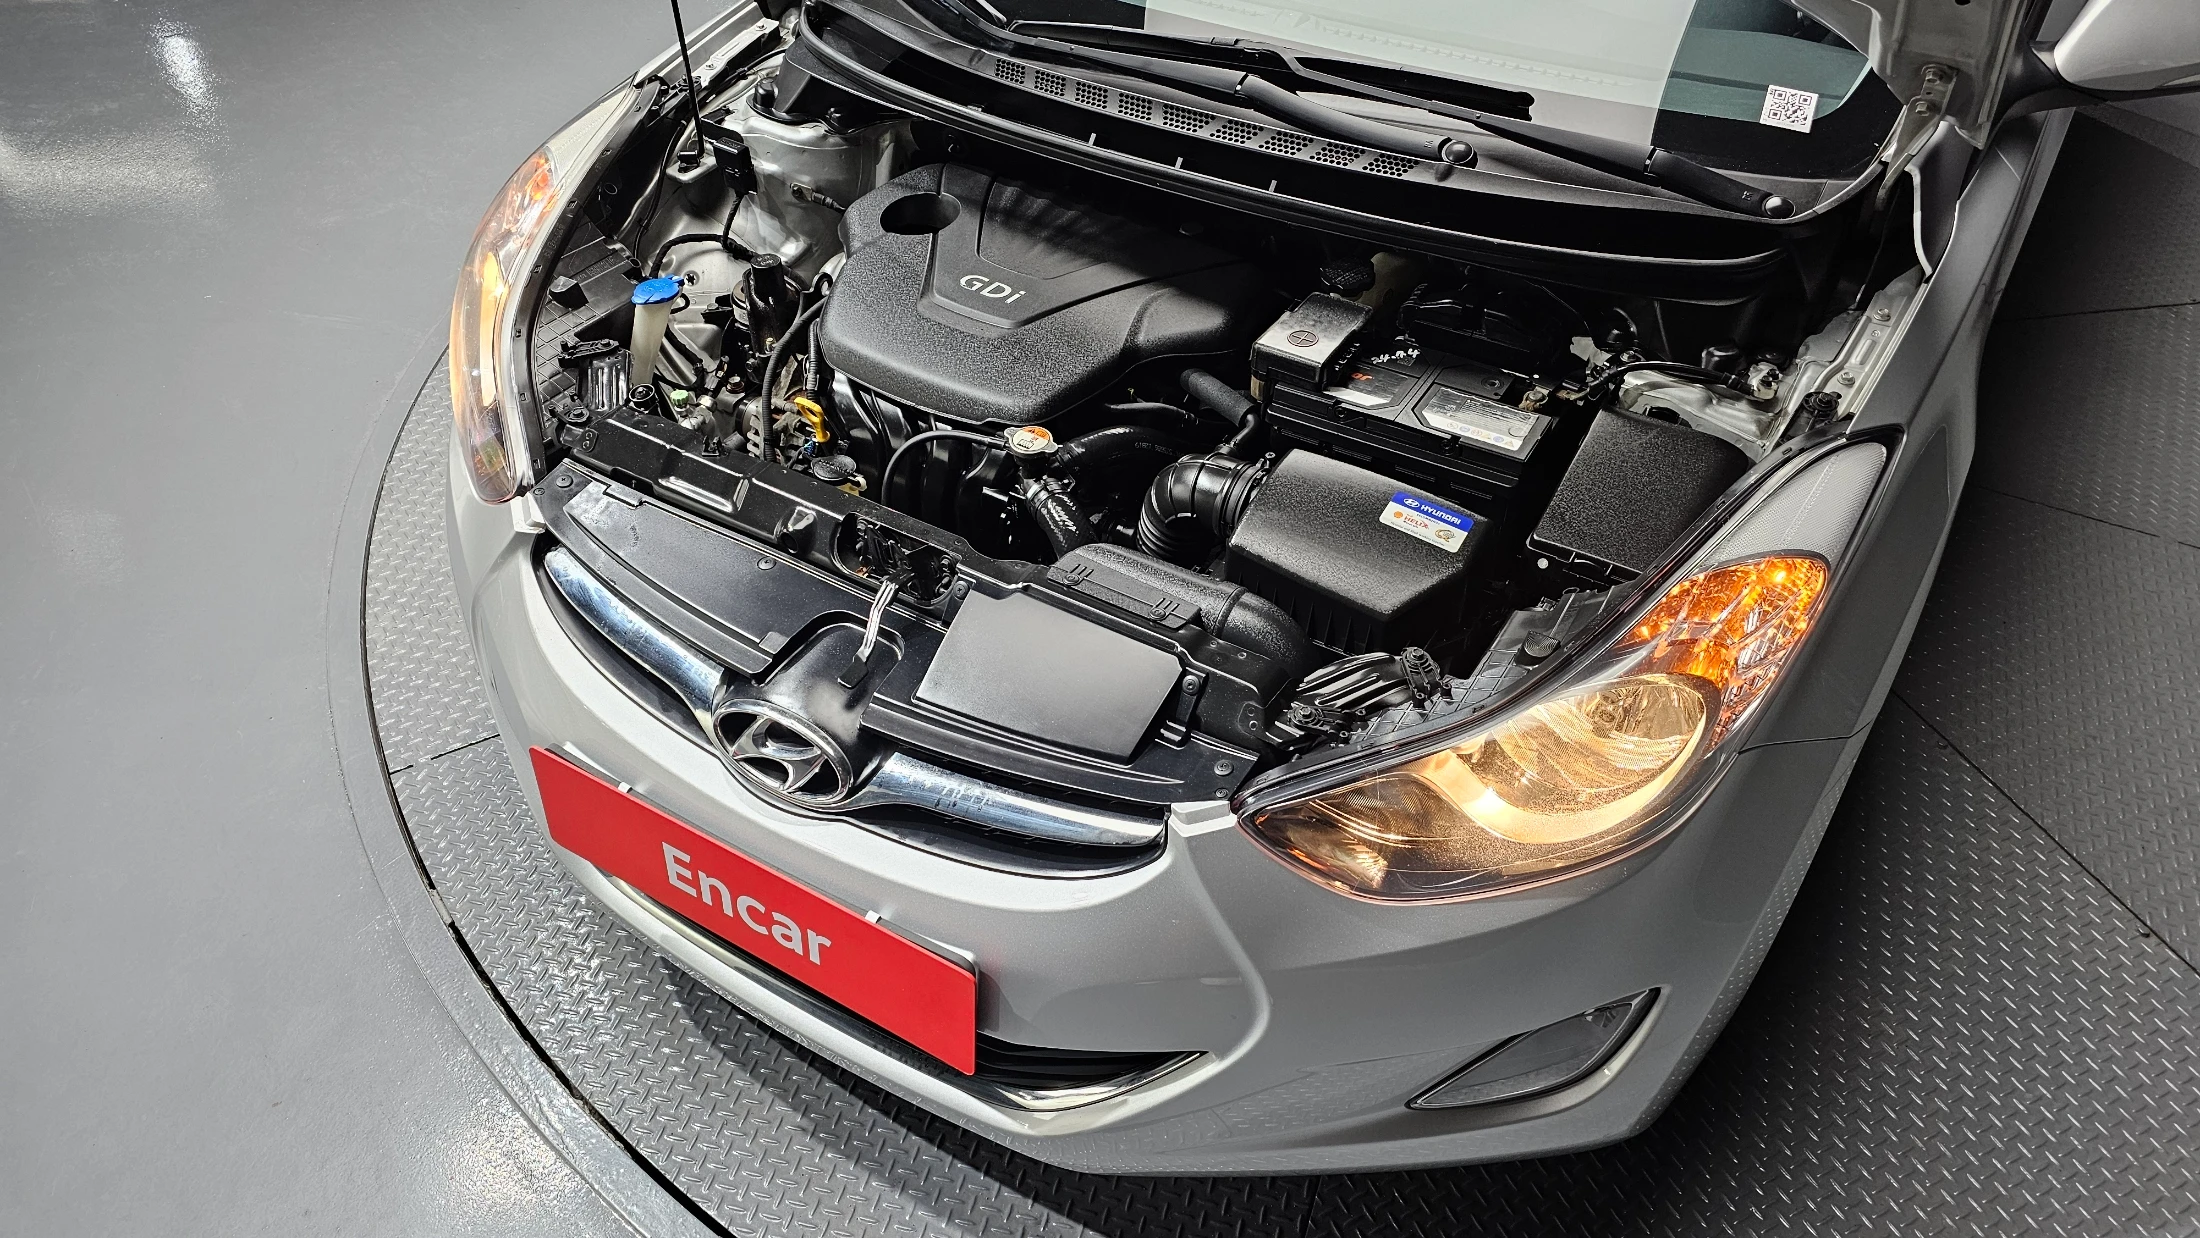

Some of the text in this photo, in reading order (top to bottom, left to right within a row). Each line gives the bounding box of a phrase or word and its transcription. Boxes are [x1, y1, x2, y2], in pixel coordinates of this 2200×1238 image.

[959, 274, 1027, 304] GDi
[1404, 515, 1429, 529] HELIX
[1420, 504, 1462, 525] HYUNDAI
[661, 841, 832, 966] Encar
